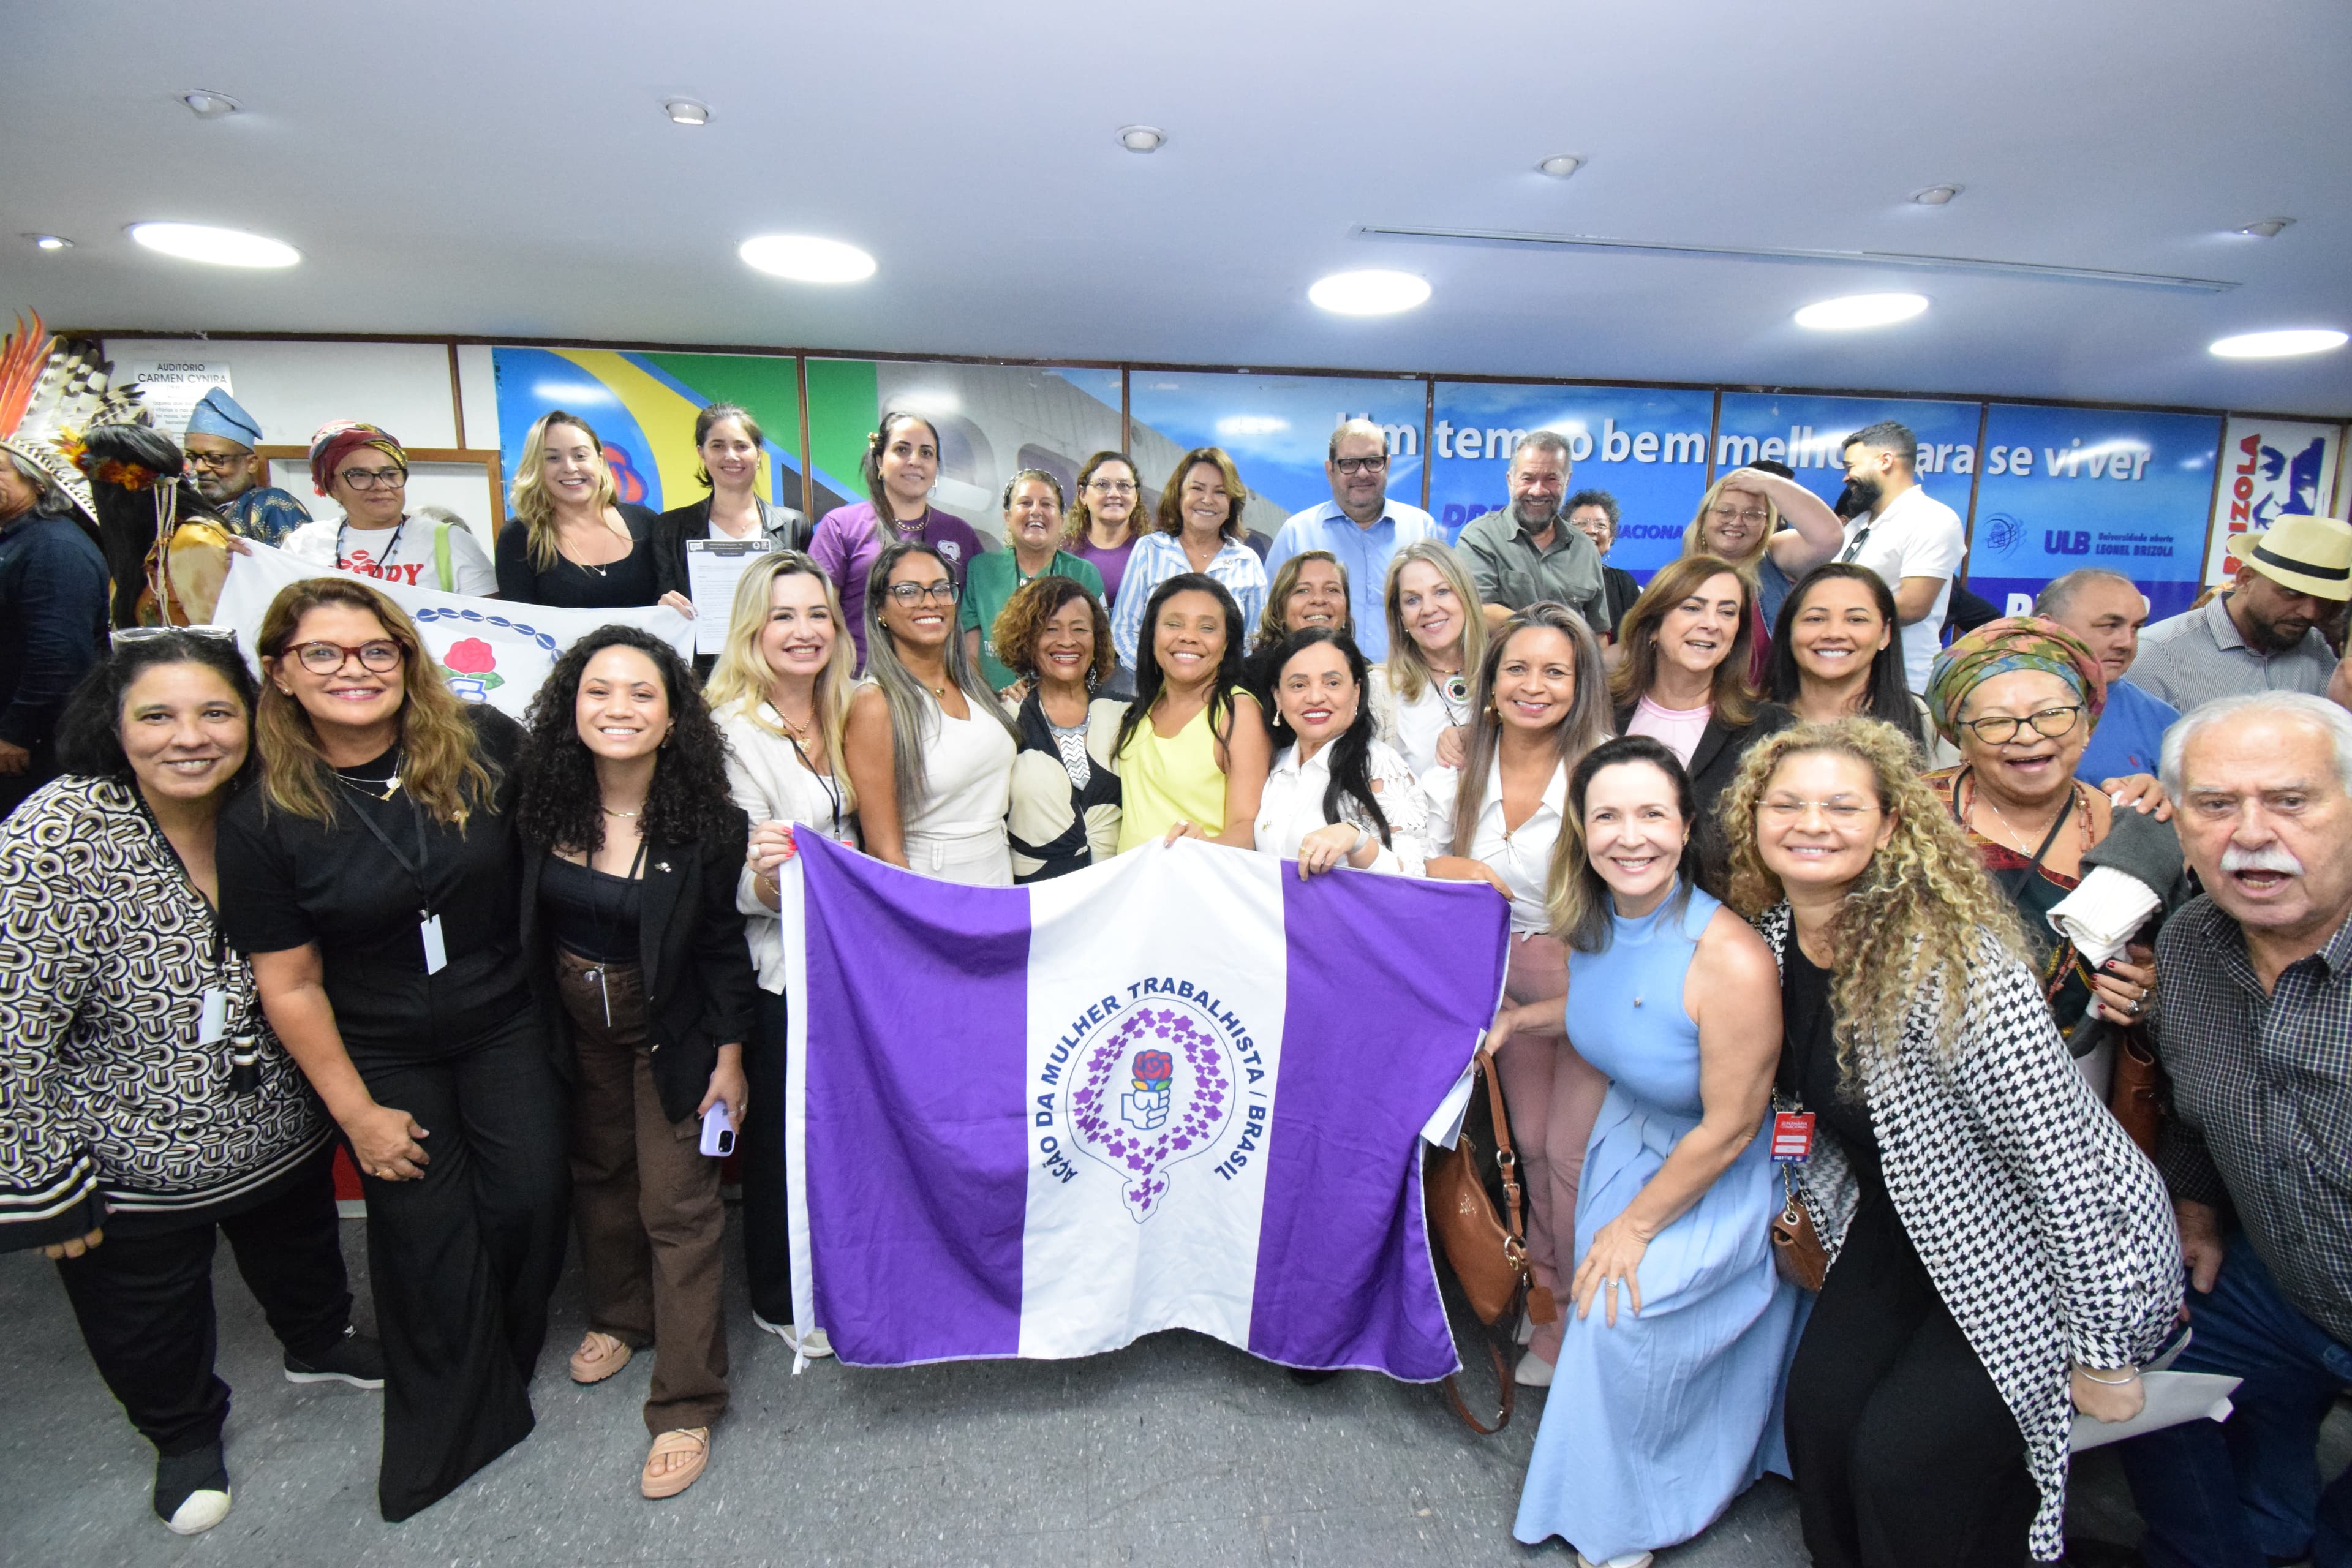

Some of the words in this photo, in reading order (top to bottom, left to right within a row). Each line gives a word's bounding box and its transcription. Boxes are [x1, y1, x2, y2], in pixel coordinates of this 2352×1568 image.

[138, 374, 184, 383] CARMEN
[187, 374, 227, 383] CYNIRA
[157, 361, 205, 371] AUDITÓRIO
[1435, 419, 1593, 461] temo
[1601, 418, 1706, 463] bem
[1717, 424, 1846, 470] melho
[1915, 442, 1975, 474] ara
[1988, 445, 2033, 476] se
[2044, 437, 2152, 480] viver
[2223, 433, 2261, 575] BIZOLA
[1618, 524, 1684, 539] ACIONA
[2044, 530, 2091, 556] ULB
[2096, 545, 2130, 555] LEONEL
[2133, 545, 2173, 557] BRIZOLA
[1041, 995, 1121, 1086] MULHER
[1127, 977, 1265, 1084] TRABALHISTA
[1036, 1092, 1055, 1127] DA
[1040, 1136, 1079, 1184] AÇÃO
[1214, 1105, 1267, 1181] BRASIL
